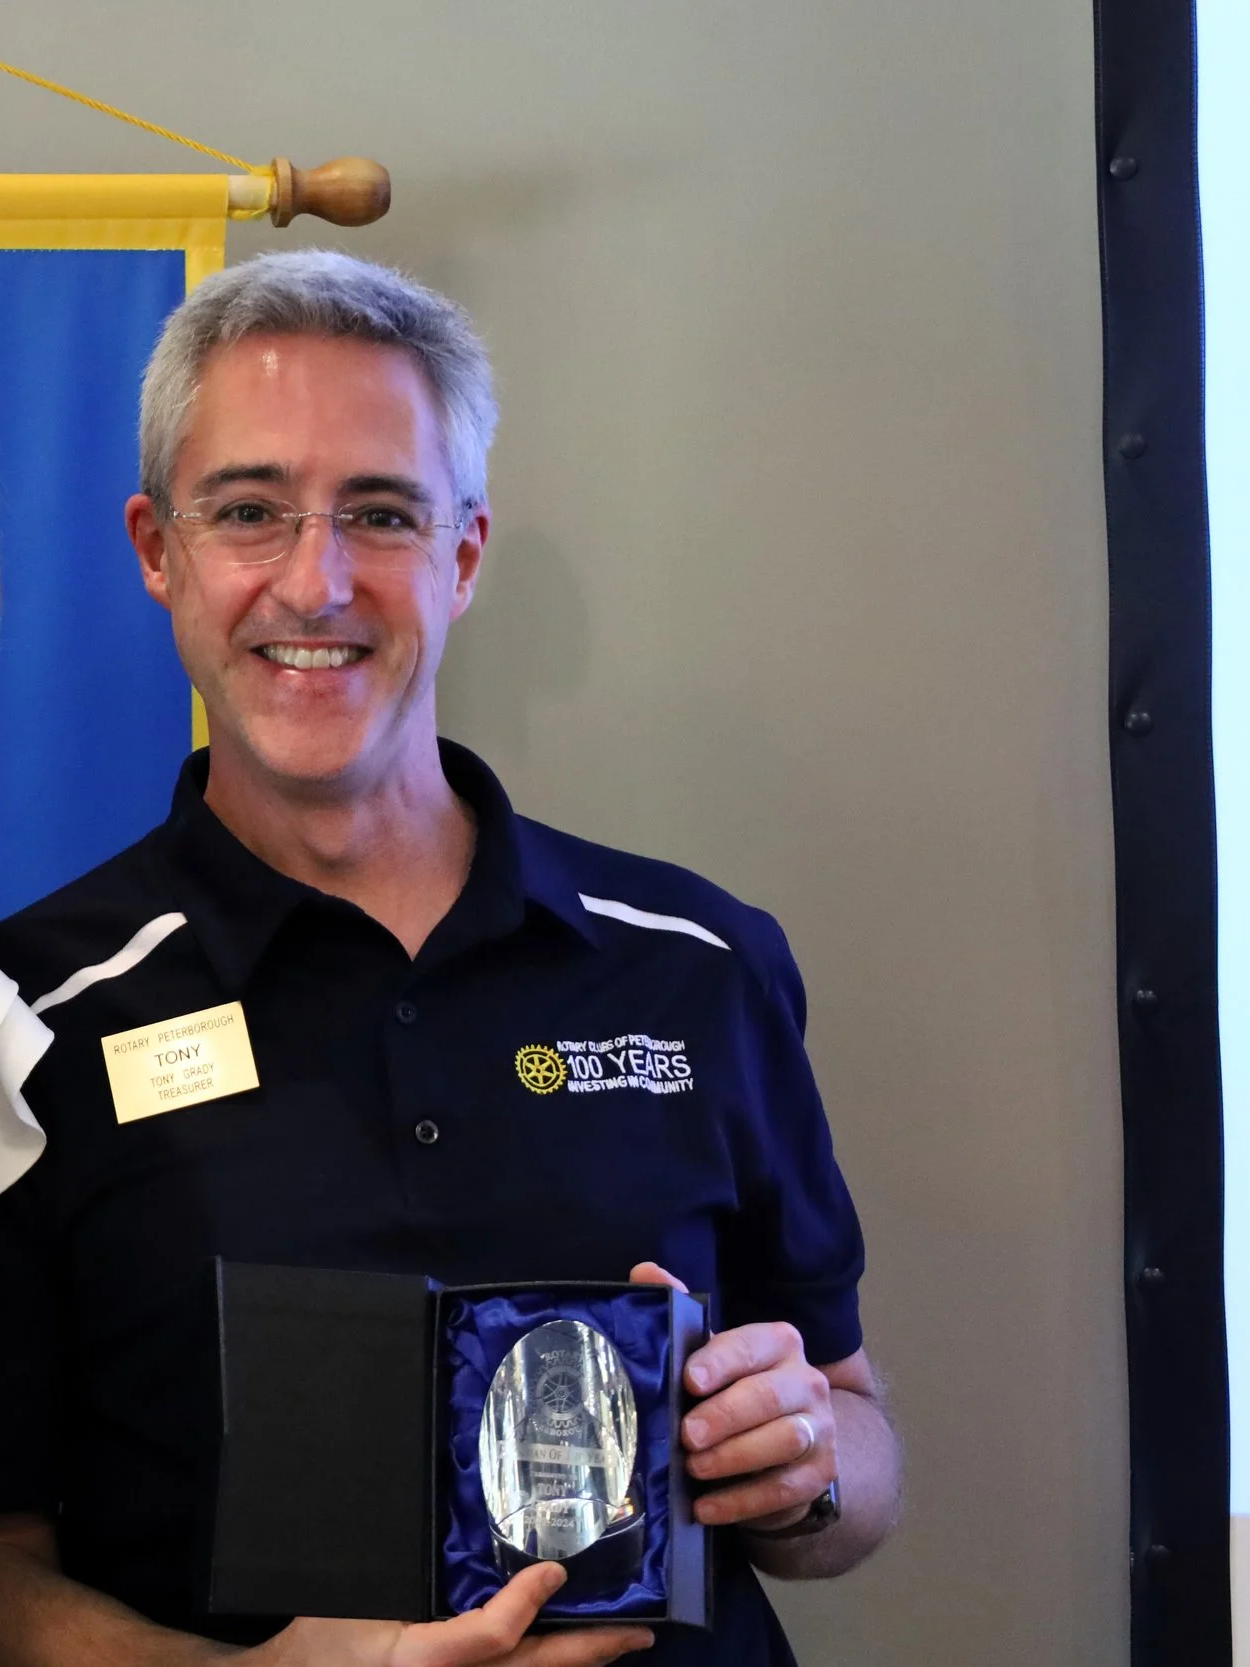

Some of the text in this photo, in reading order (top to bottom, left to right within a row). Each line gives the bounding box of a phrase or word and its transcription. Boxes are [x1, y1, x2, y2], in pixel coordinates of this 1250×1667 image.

[113, 1014, 235, 1055] ROTARY PETERBOROUGH
[556, 1040, 587, 1052] ROTARY
[614, 1035, 628, 1048] OF
[627, 1033, 686, 1052] PETOROUGH
[153, 1044, 202, 1068] TONY
[566, 1049, 692, 1080] 100 YEARS
[149, 1062, 215, 1089] TONY GRADY
[567, 1075, 628, 1093] INVESTING
[627, 1075, 640, 1088] IN
[157, 1077, 215, 1101] TREASURER
[537, 1483, 567, 1497] TONY
